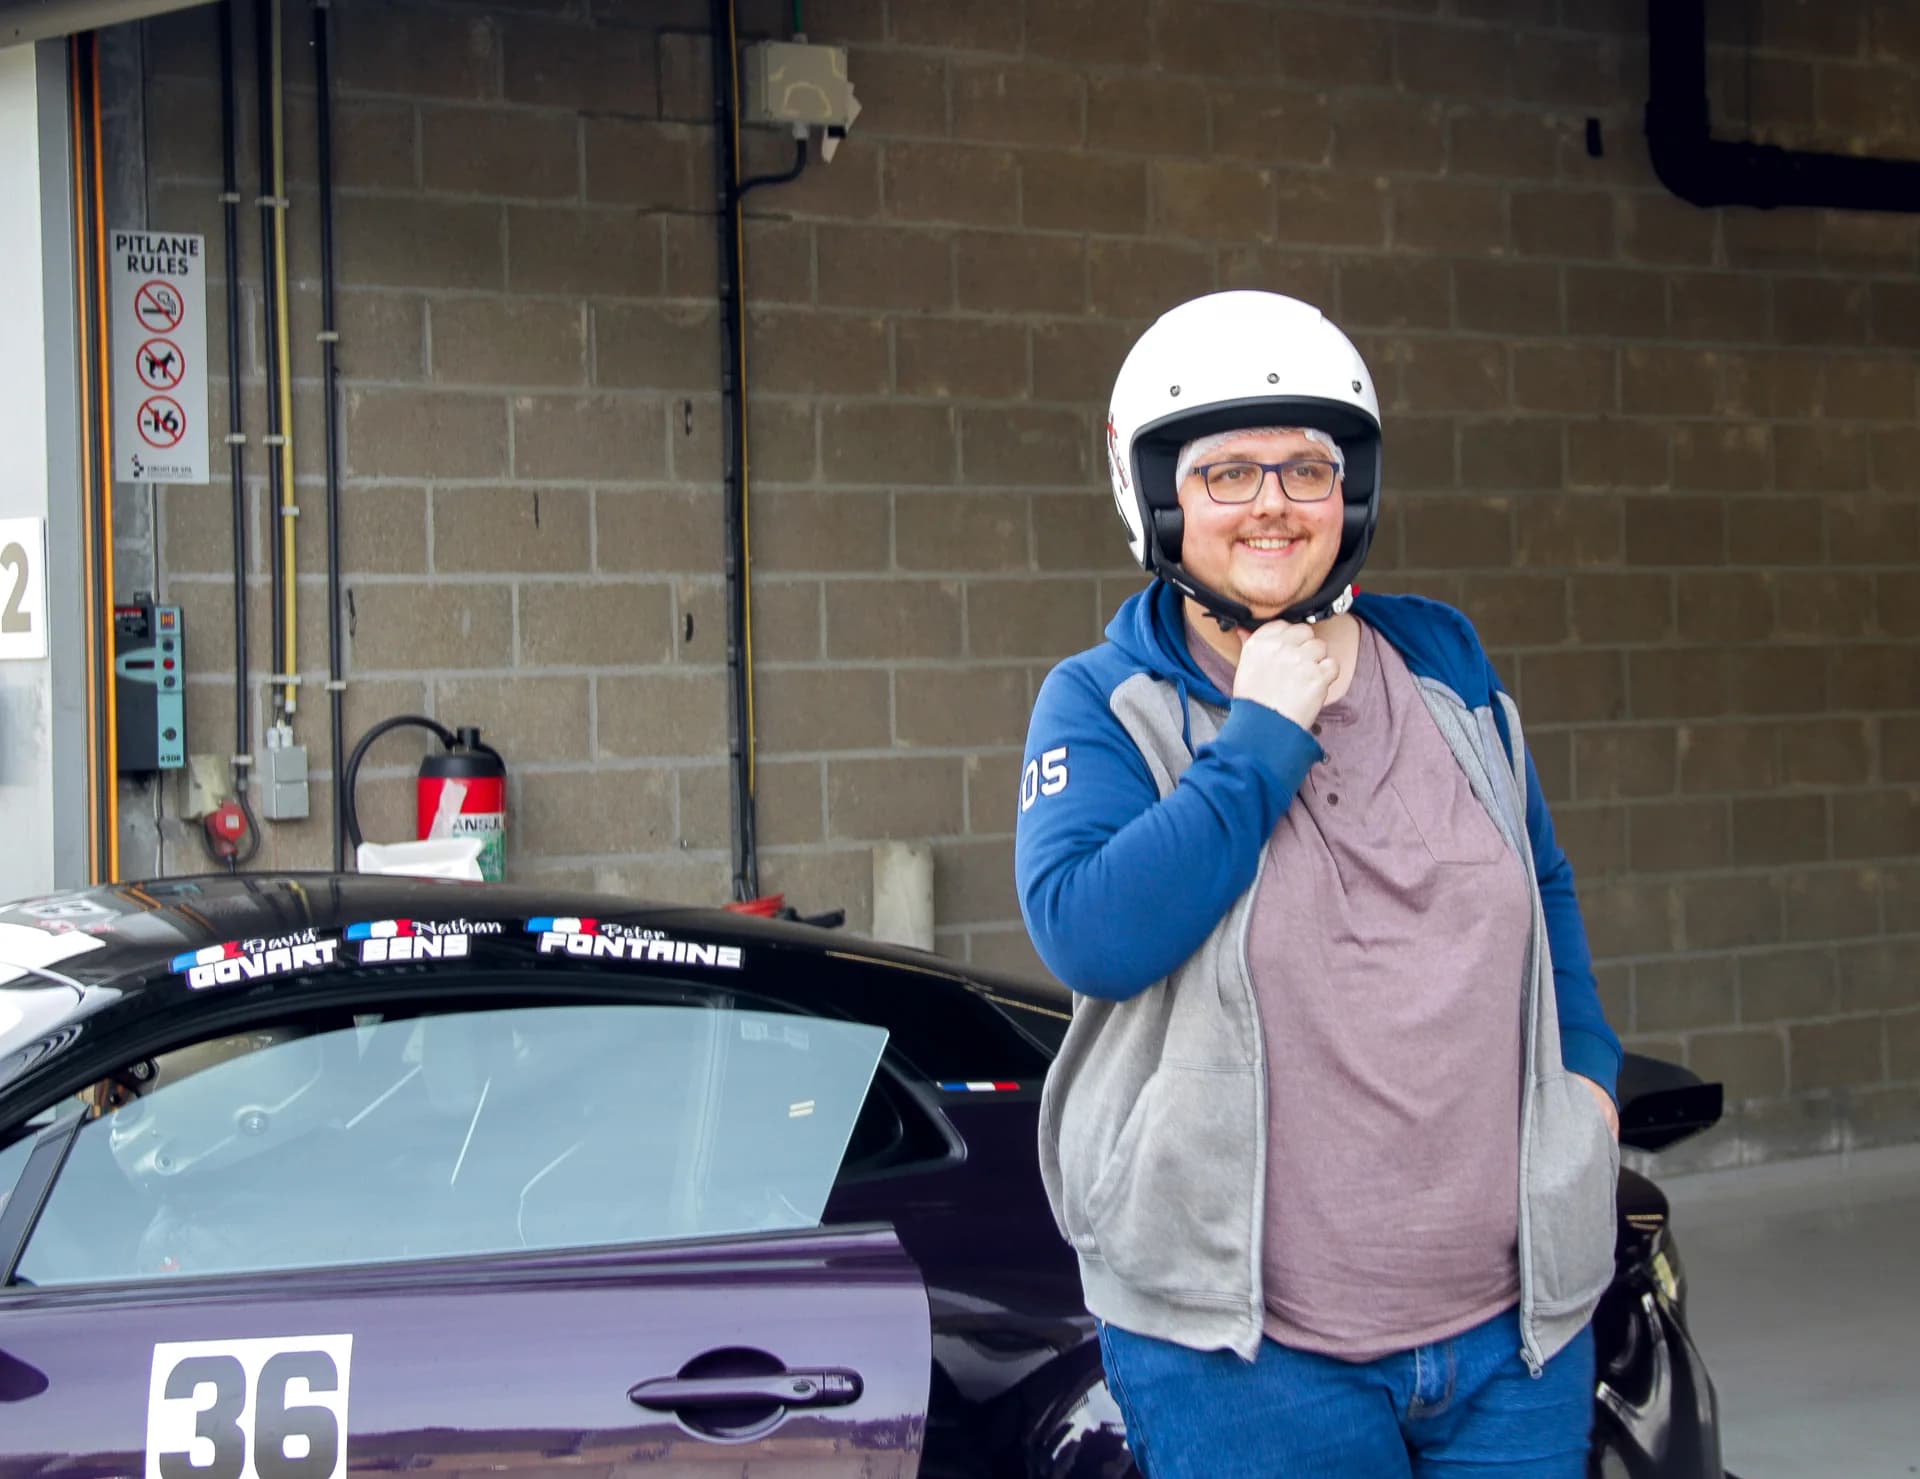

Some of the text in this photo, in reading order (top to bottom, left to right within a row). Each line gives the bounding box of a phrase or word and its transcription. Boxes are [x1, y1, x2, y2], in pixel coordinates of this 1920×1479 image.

[116, 234, 199, 256] PITLANE
[127, 254, 189, 275] RULES
[0, 541, 32, 633] 2
[411, 918, 502, 936] Nathan
[601, 923, 666, 940] Peter
[242, 927, 317, 953] David
[540, 931, 742, 968] FONTAINE
[159, 1350, 339, 1479] 36
